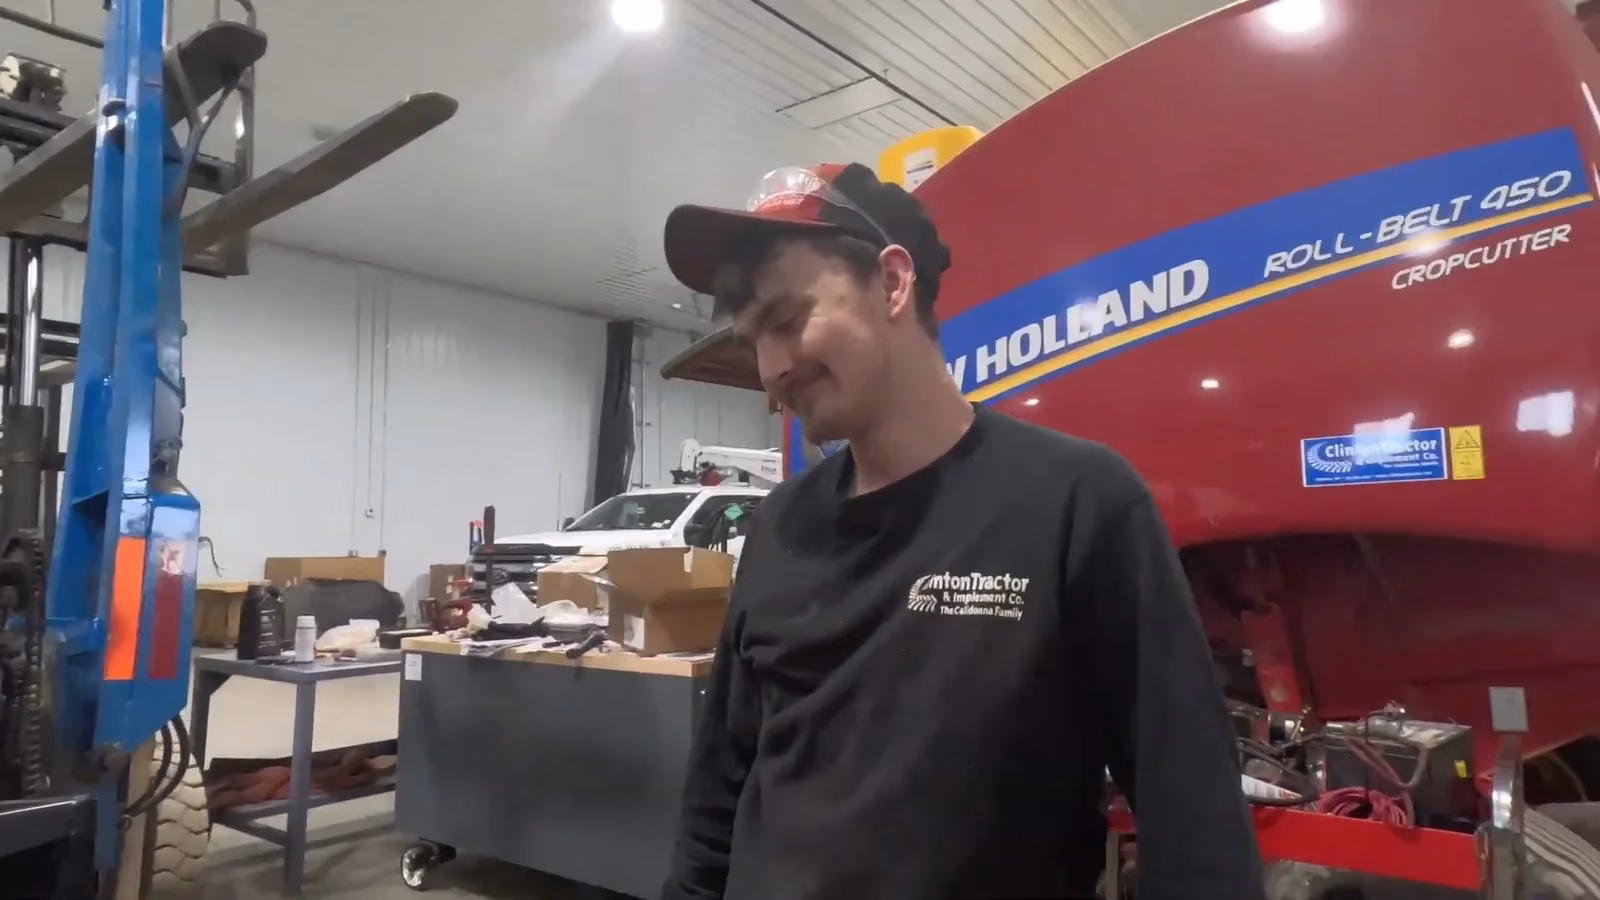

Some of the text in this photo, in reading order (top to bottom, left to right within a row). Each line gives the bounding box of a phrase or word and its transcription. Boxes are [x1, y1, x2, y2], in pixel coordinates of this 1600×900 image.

[1480, 169, 1572, 210] 450
[1391, 223, 1571, 290] CROPCUTTER
[976, 259, 1210, 384] HOLLAND
[940, 605, 953, 615] The
[994, 605, 1023, 621] Family
[942, 591, 1025, 605] & Implement Co.
